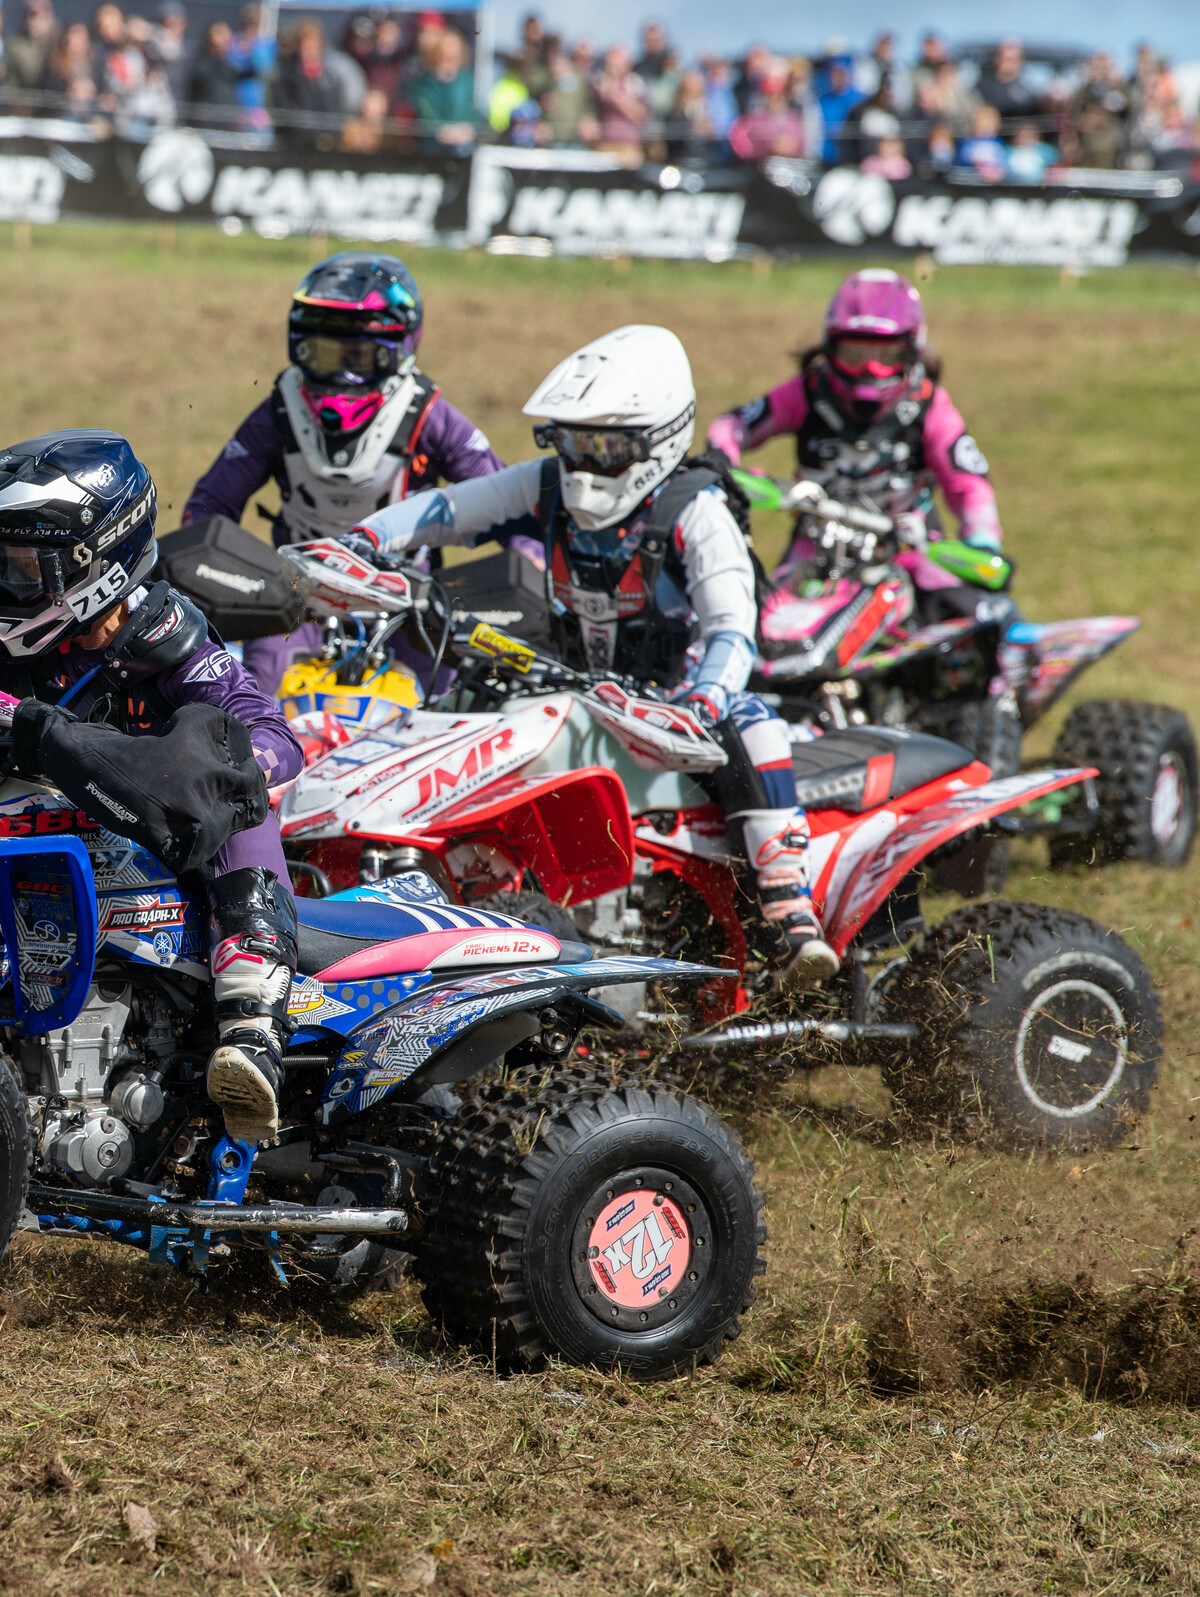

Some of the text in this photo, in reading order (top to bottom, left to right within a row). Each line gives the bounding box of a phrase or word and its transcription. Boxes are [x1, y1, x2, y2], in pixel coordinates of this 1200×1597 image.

[54, 528, 72, 536] FLY
[72, 568, 126, 617] 715
[401, 728, 514, 817] JMR
[15, 881, 67, 894] GBC
[111, 908, 179, 926] PRO GRAPH-X
[463, 945, 511, 957] PICKENS
[289, 990, 323, 1003] RCE
[363, 1069, 403, 1086] PIERCE
[662, 1206, 686, 1239] GBC
